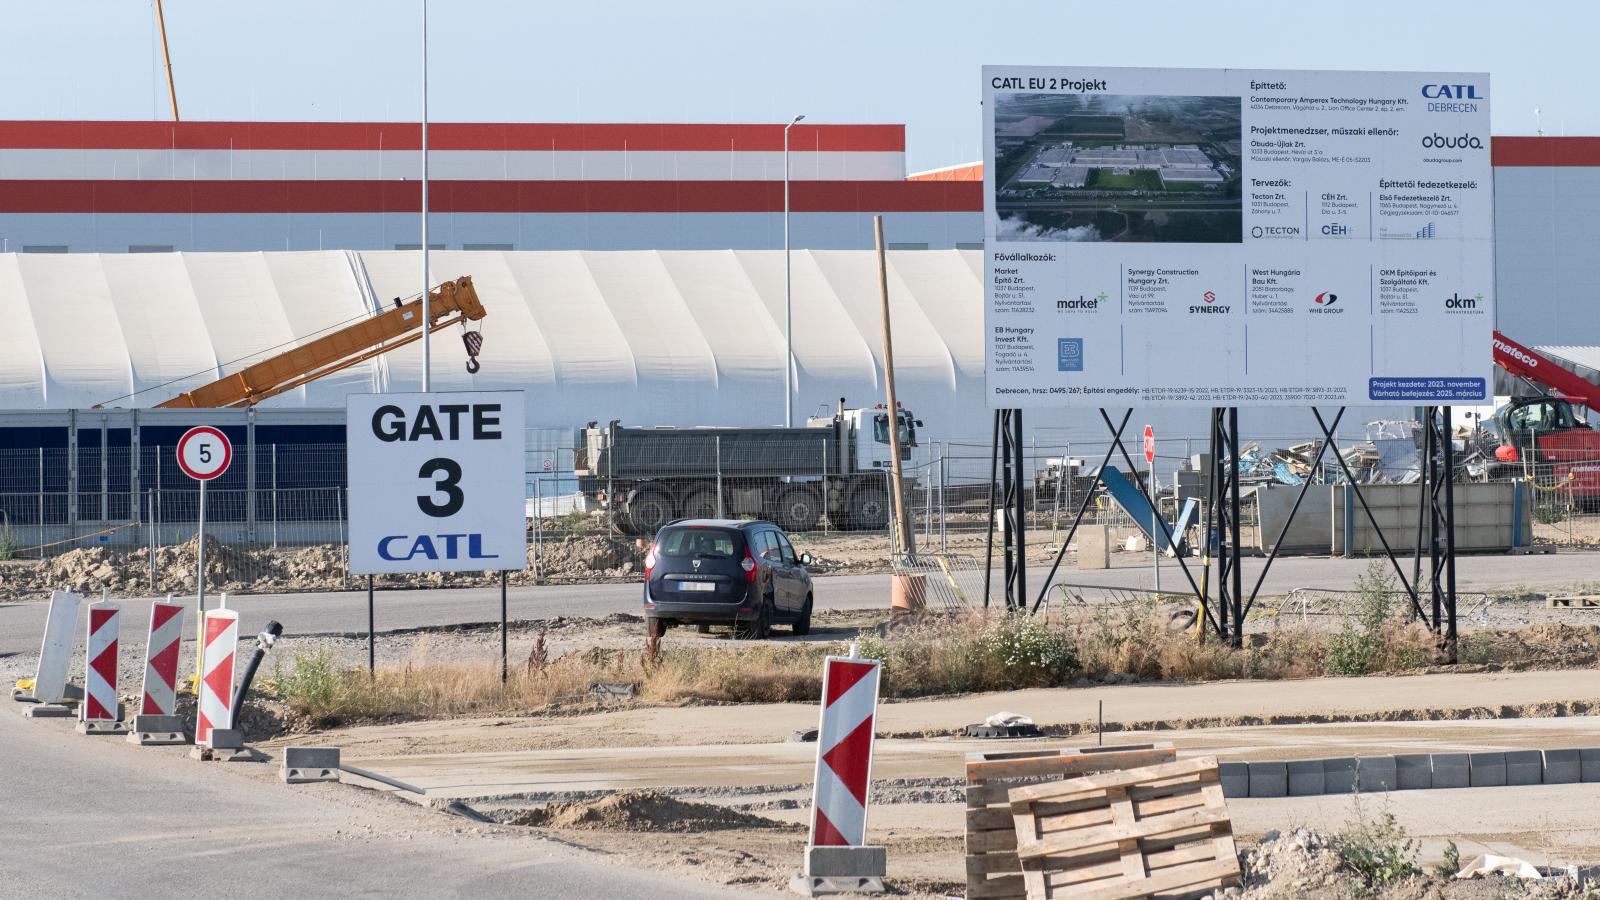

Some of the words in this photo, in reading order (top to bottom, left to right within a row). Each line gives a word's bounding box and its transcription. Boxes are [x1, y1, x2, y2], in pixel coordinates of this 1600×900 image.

[992, 77, 1025, 89] CATL
[1029, 78, 1046, 89] EU
[1050, 78, 1057, 90] 2
[1061, 78, 1107, 93] Projekt
[1422, 84, 1483, 100] CATL
[1250, 96, 1298, 105] Contemporary
[1300, 97, 1328, 105] Amperex
[1331, 97, 1367, 106] Technology
[1369, 98, 1396, 106] Hungary
[1428, 103, 1477, 112] DEBRECEN
[1250, 126, 1329, 136] Projektmenedzser,
[1332, 127, 1366, 136] műszaki
[1251, 178, 1292, 188] Tervezők:
[1379, 178, 1416, 190] Építtetői
[1417, 180, 1478, 190] fedezetkezelő:
[1394, 194, 1439, 202] Fedezetkezelő
[994, 253, 1056, 262] Fővállalkozók:
[1128, 269, 1155, 277] Synergy
[1128, 278, 1156, 286] Hungary
[1057, 296, 1098, 309] market
[1445, 293, 1476, 309] okm
[1189, 306, 1231, 314] SYNERGY
[1006, 327, 1034, 335] Hungary
[1493, 339, 1538, 368] mateco
[1373, 381, 1396, 389] Projekt
[996, 388, 1031, 396] Debrecen,
[1107, 387, 1140, 396] engedély:
[1401, 390, 1435, 399] befejezés:
[372, 404, 502, 442] GATE
[200, 444, 211, 464] 5
[417, 457, 465, 518] 3
[378, 534, 499, 561] CATL
